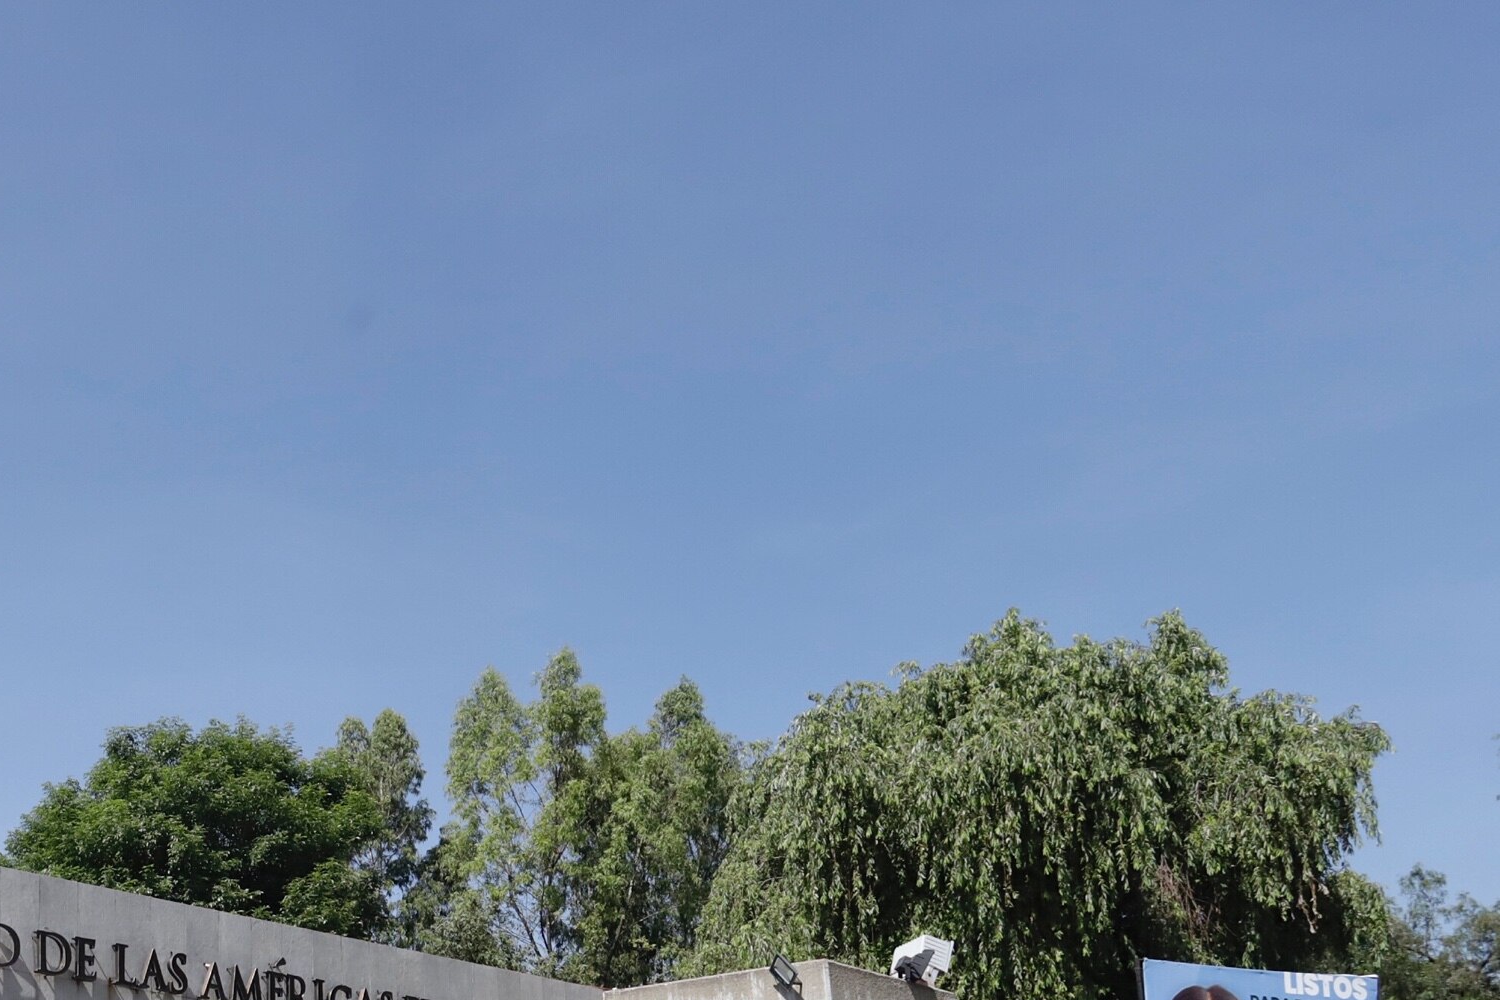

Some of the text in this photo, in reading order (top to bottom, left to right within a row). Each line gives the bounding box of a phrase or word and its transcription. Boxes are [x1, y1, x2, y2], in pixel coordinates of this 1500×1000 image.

[33, 928, 98, 982] DE
[111, 942, 188, 995] LAS
[1283, 971, 1368, 1000] LISTOS
